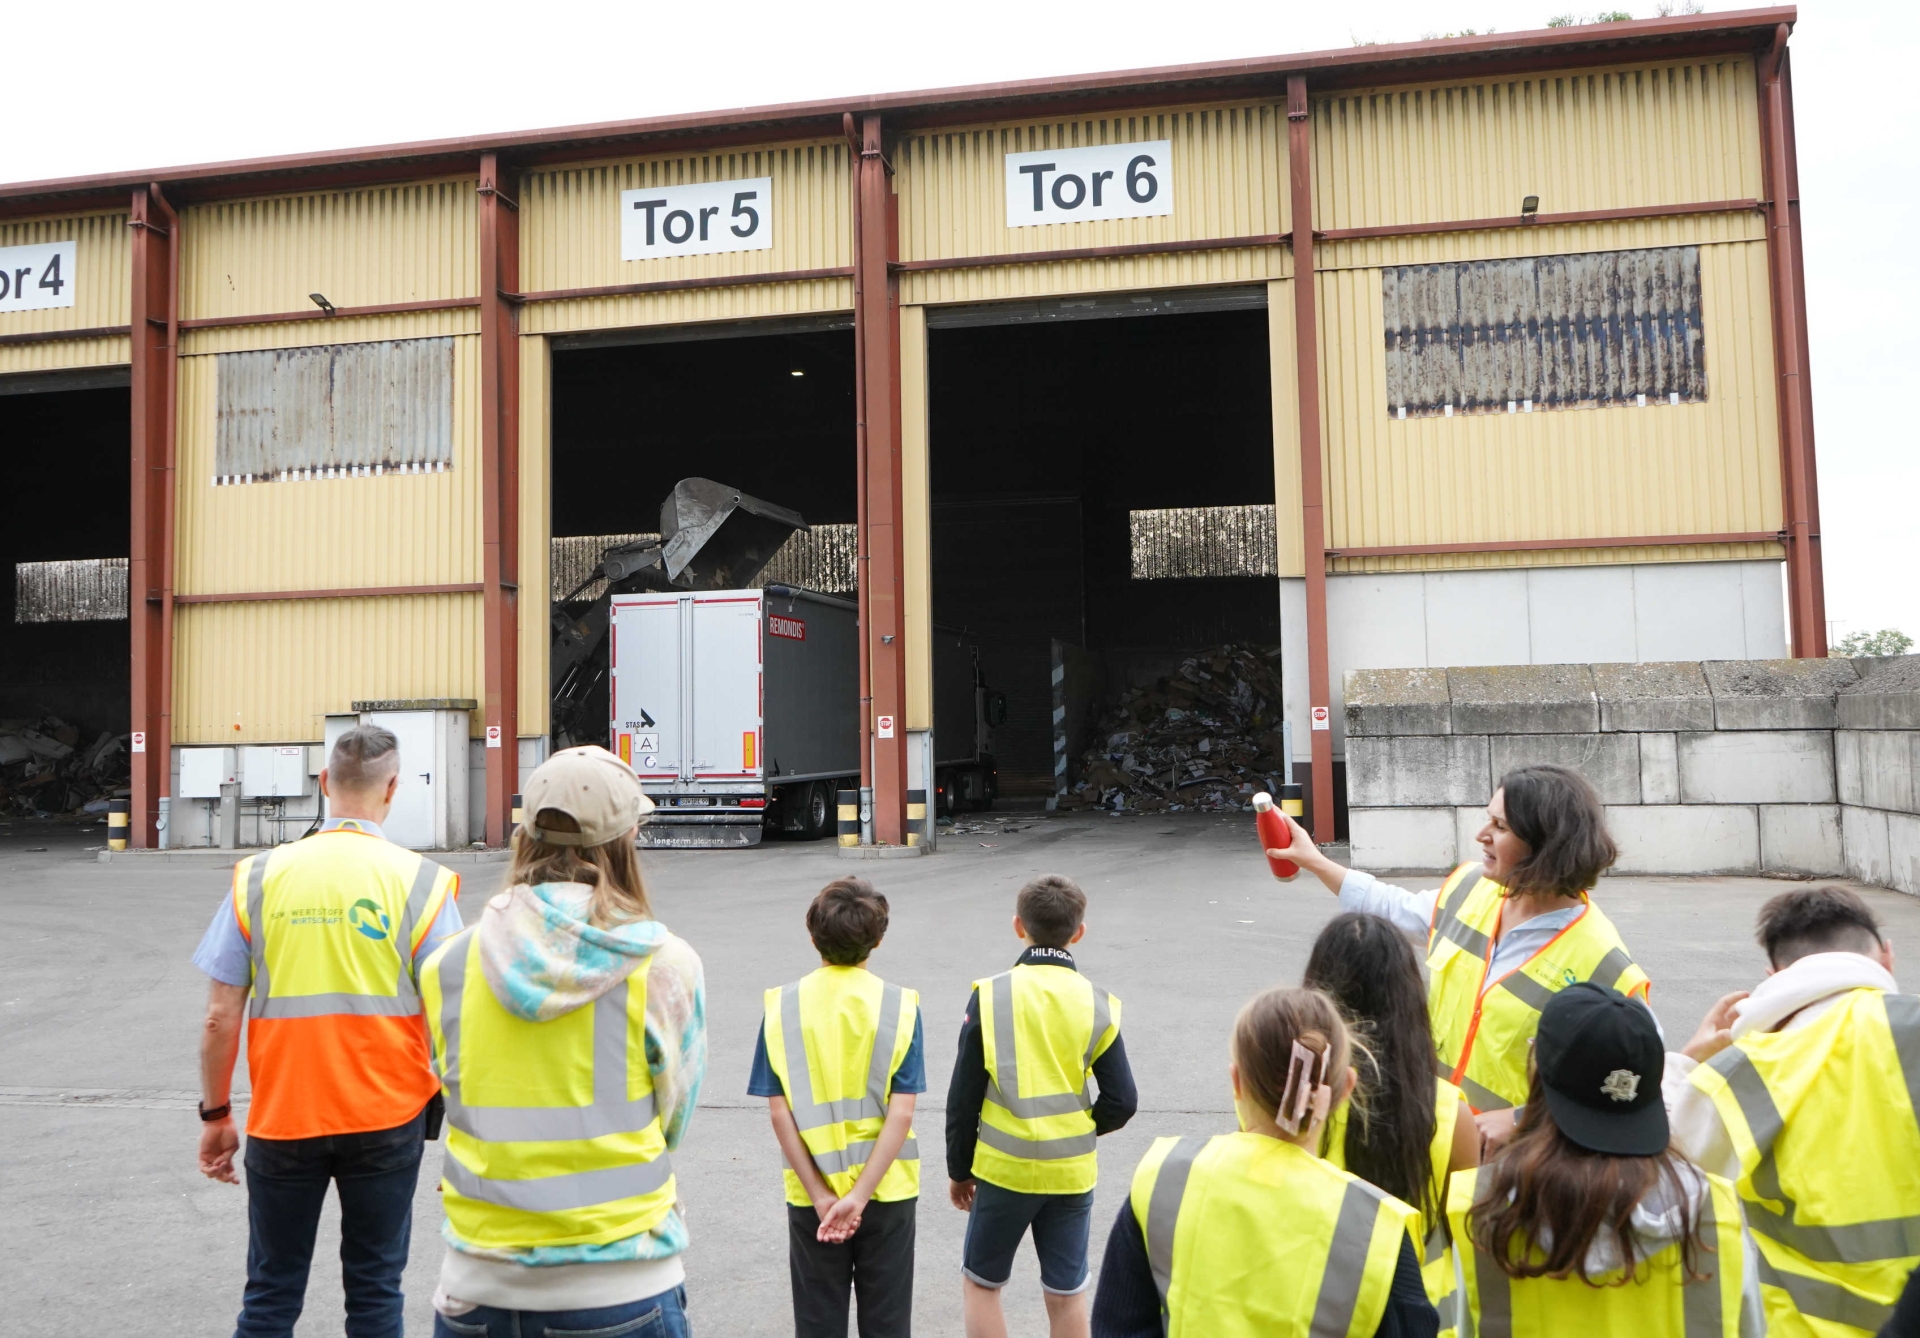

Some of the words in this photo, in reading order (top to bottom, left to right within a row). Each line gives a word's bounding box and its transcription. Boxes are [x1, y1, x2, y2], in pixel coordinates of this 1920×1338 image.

[1019, 162, 1114, 212] Tor
[1125, 154, 1158, 204] 6
[633, 199, 720, 246] Tor
[730, 191, 759, 238] 5
[38, 253, 65, 296] 4
[625, 721, 641, 729] STAS
[640, 737, 653, 750] A
[653, 837, 691, 846] long-term
[291, 908, 344, 917] WERTSTOFF
[291, 917, 344, 925] WIRTSCHAFT
